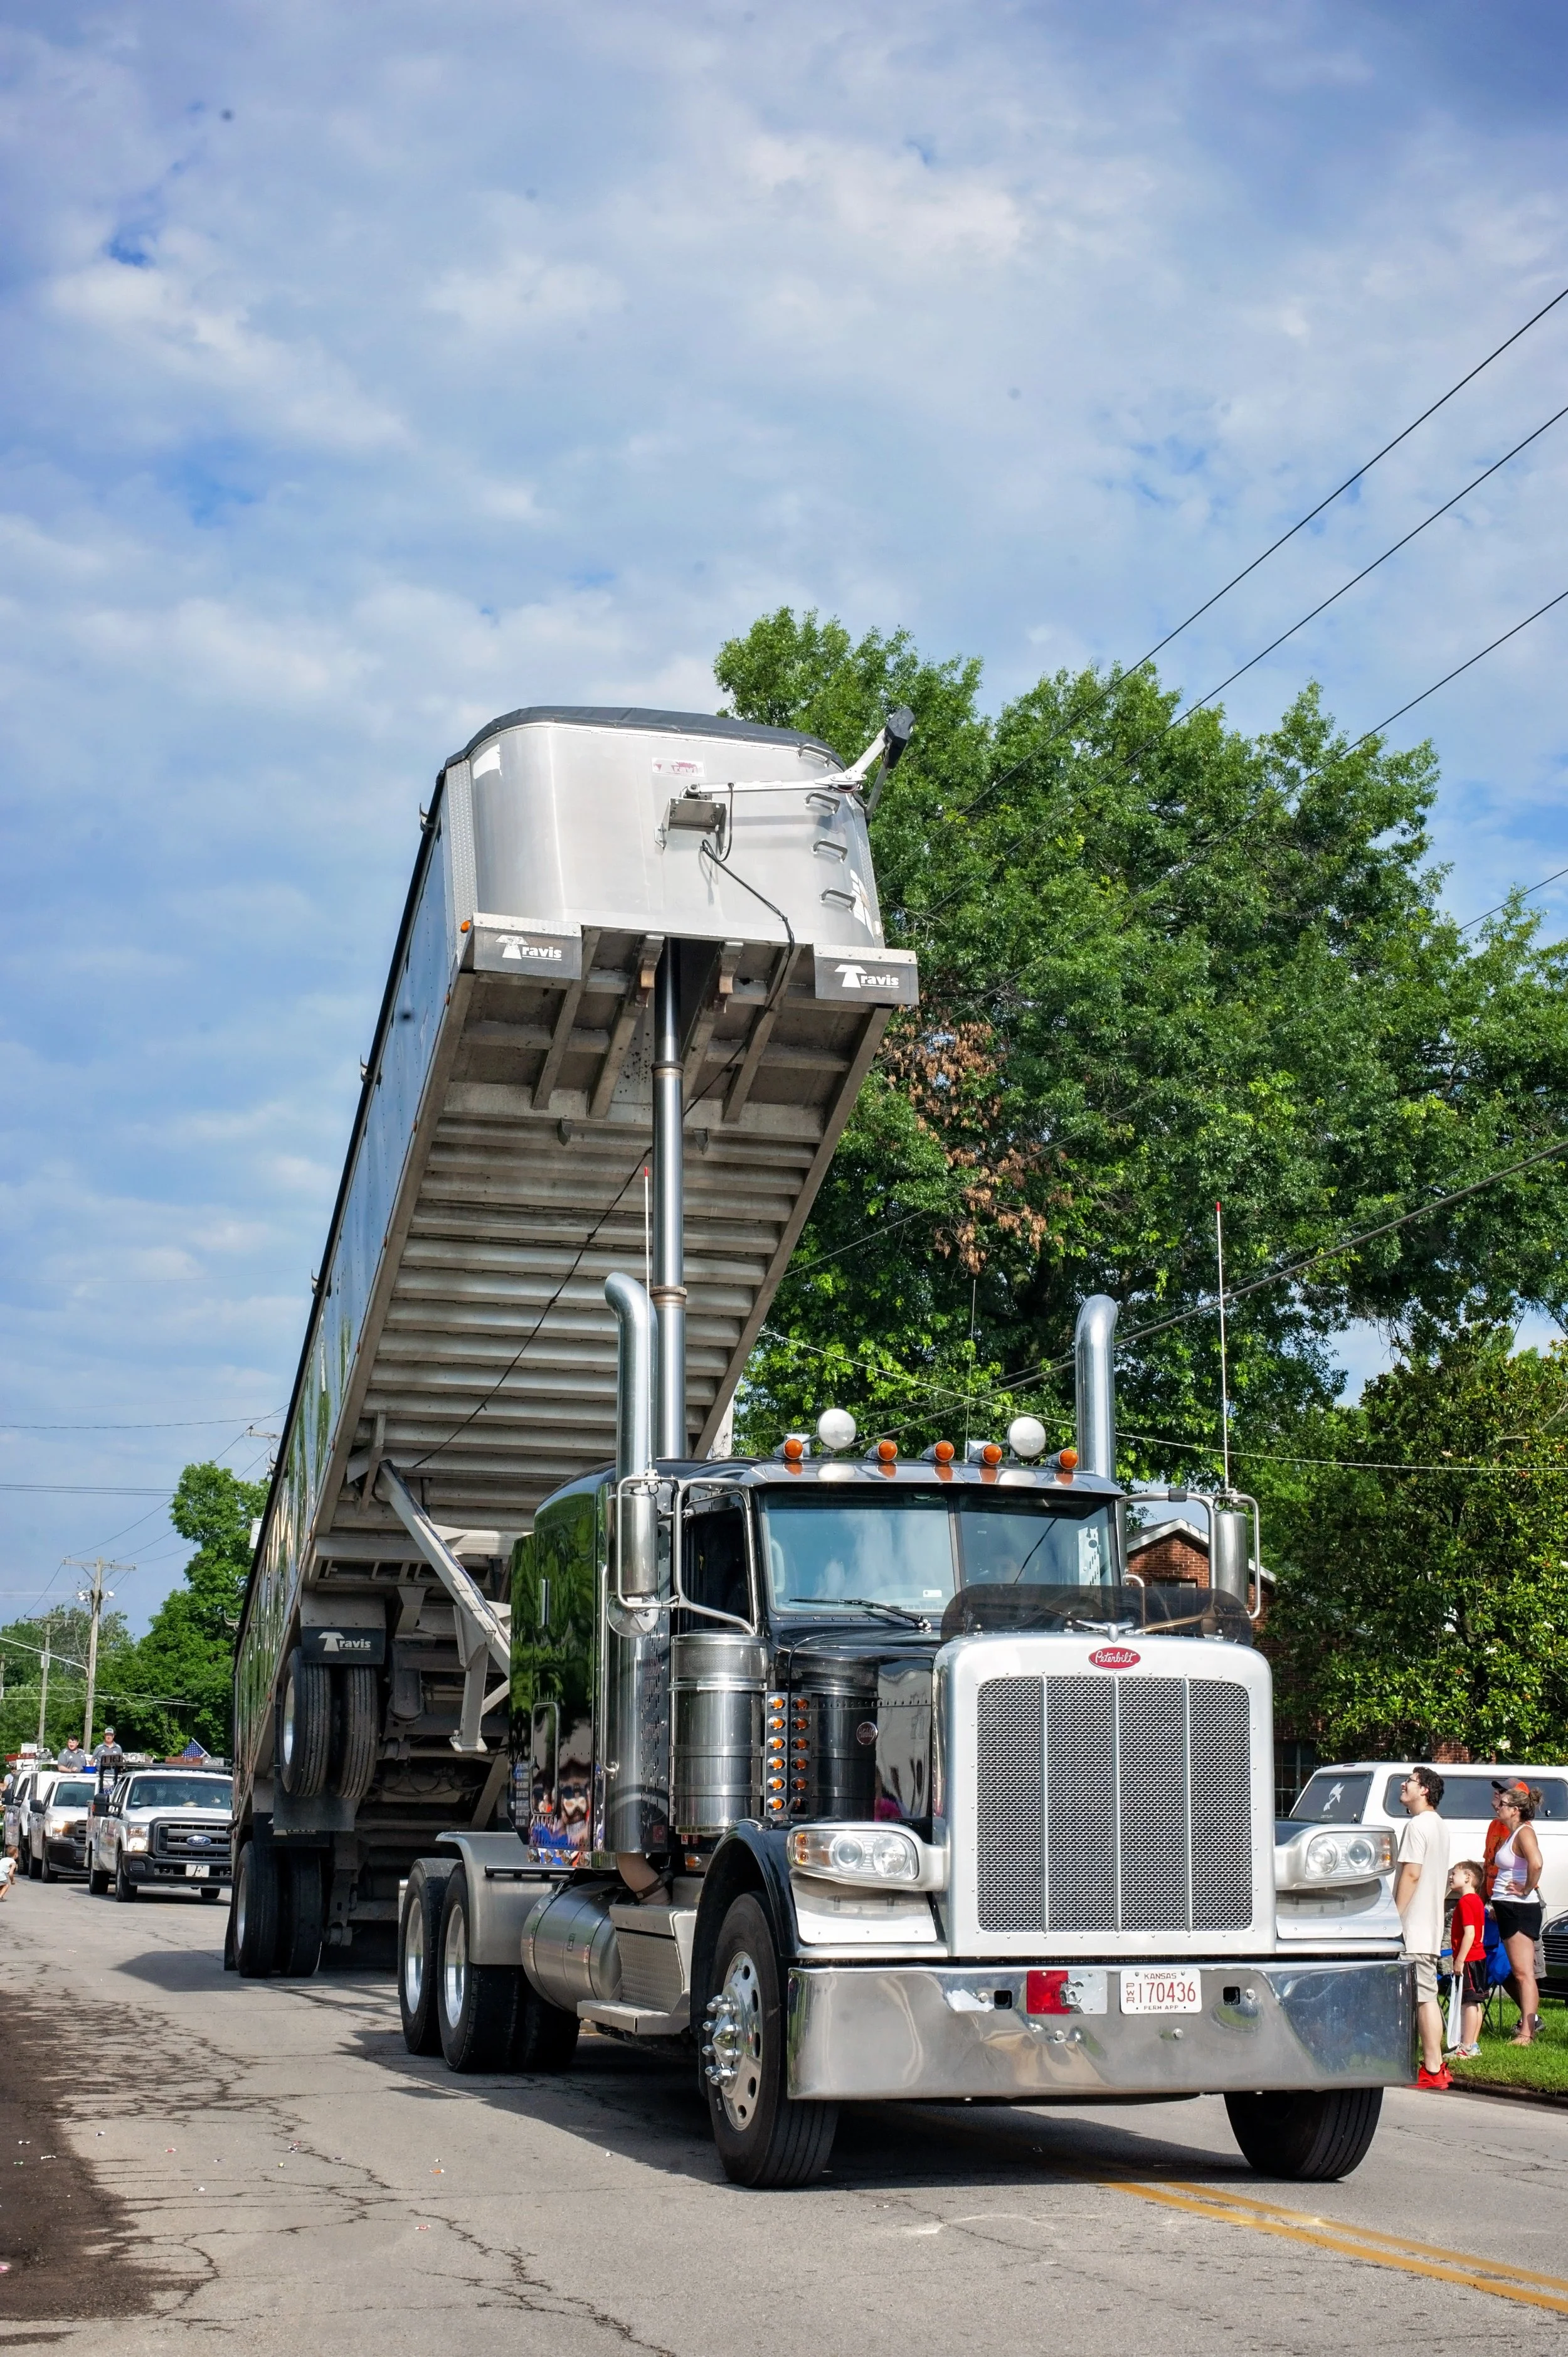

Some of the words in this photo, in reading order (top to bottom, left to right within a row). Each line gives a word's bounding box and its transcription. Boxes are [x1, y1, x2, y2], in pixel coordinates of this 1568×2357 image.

[495, 935, 562, 960] Travis
[834, 964, 899, 988] Travis
[318, 1632, 371, 1651] Travis
[1095, 1650, 1136, 1664] Peterbilt
[1126, 1983, 1135, 2003] PWR
[1139, 1982, 1195, 2003] 170436
